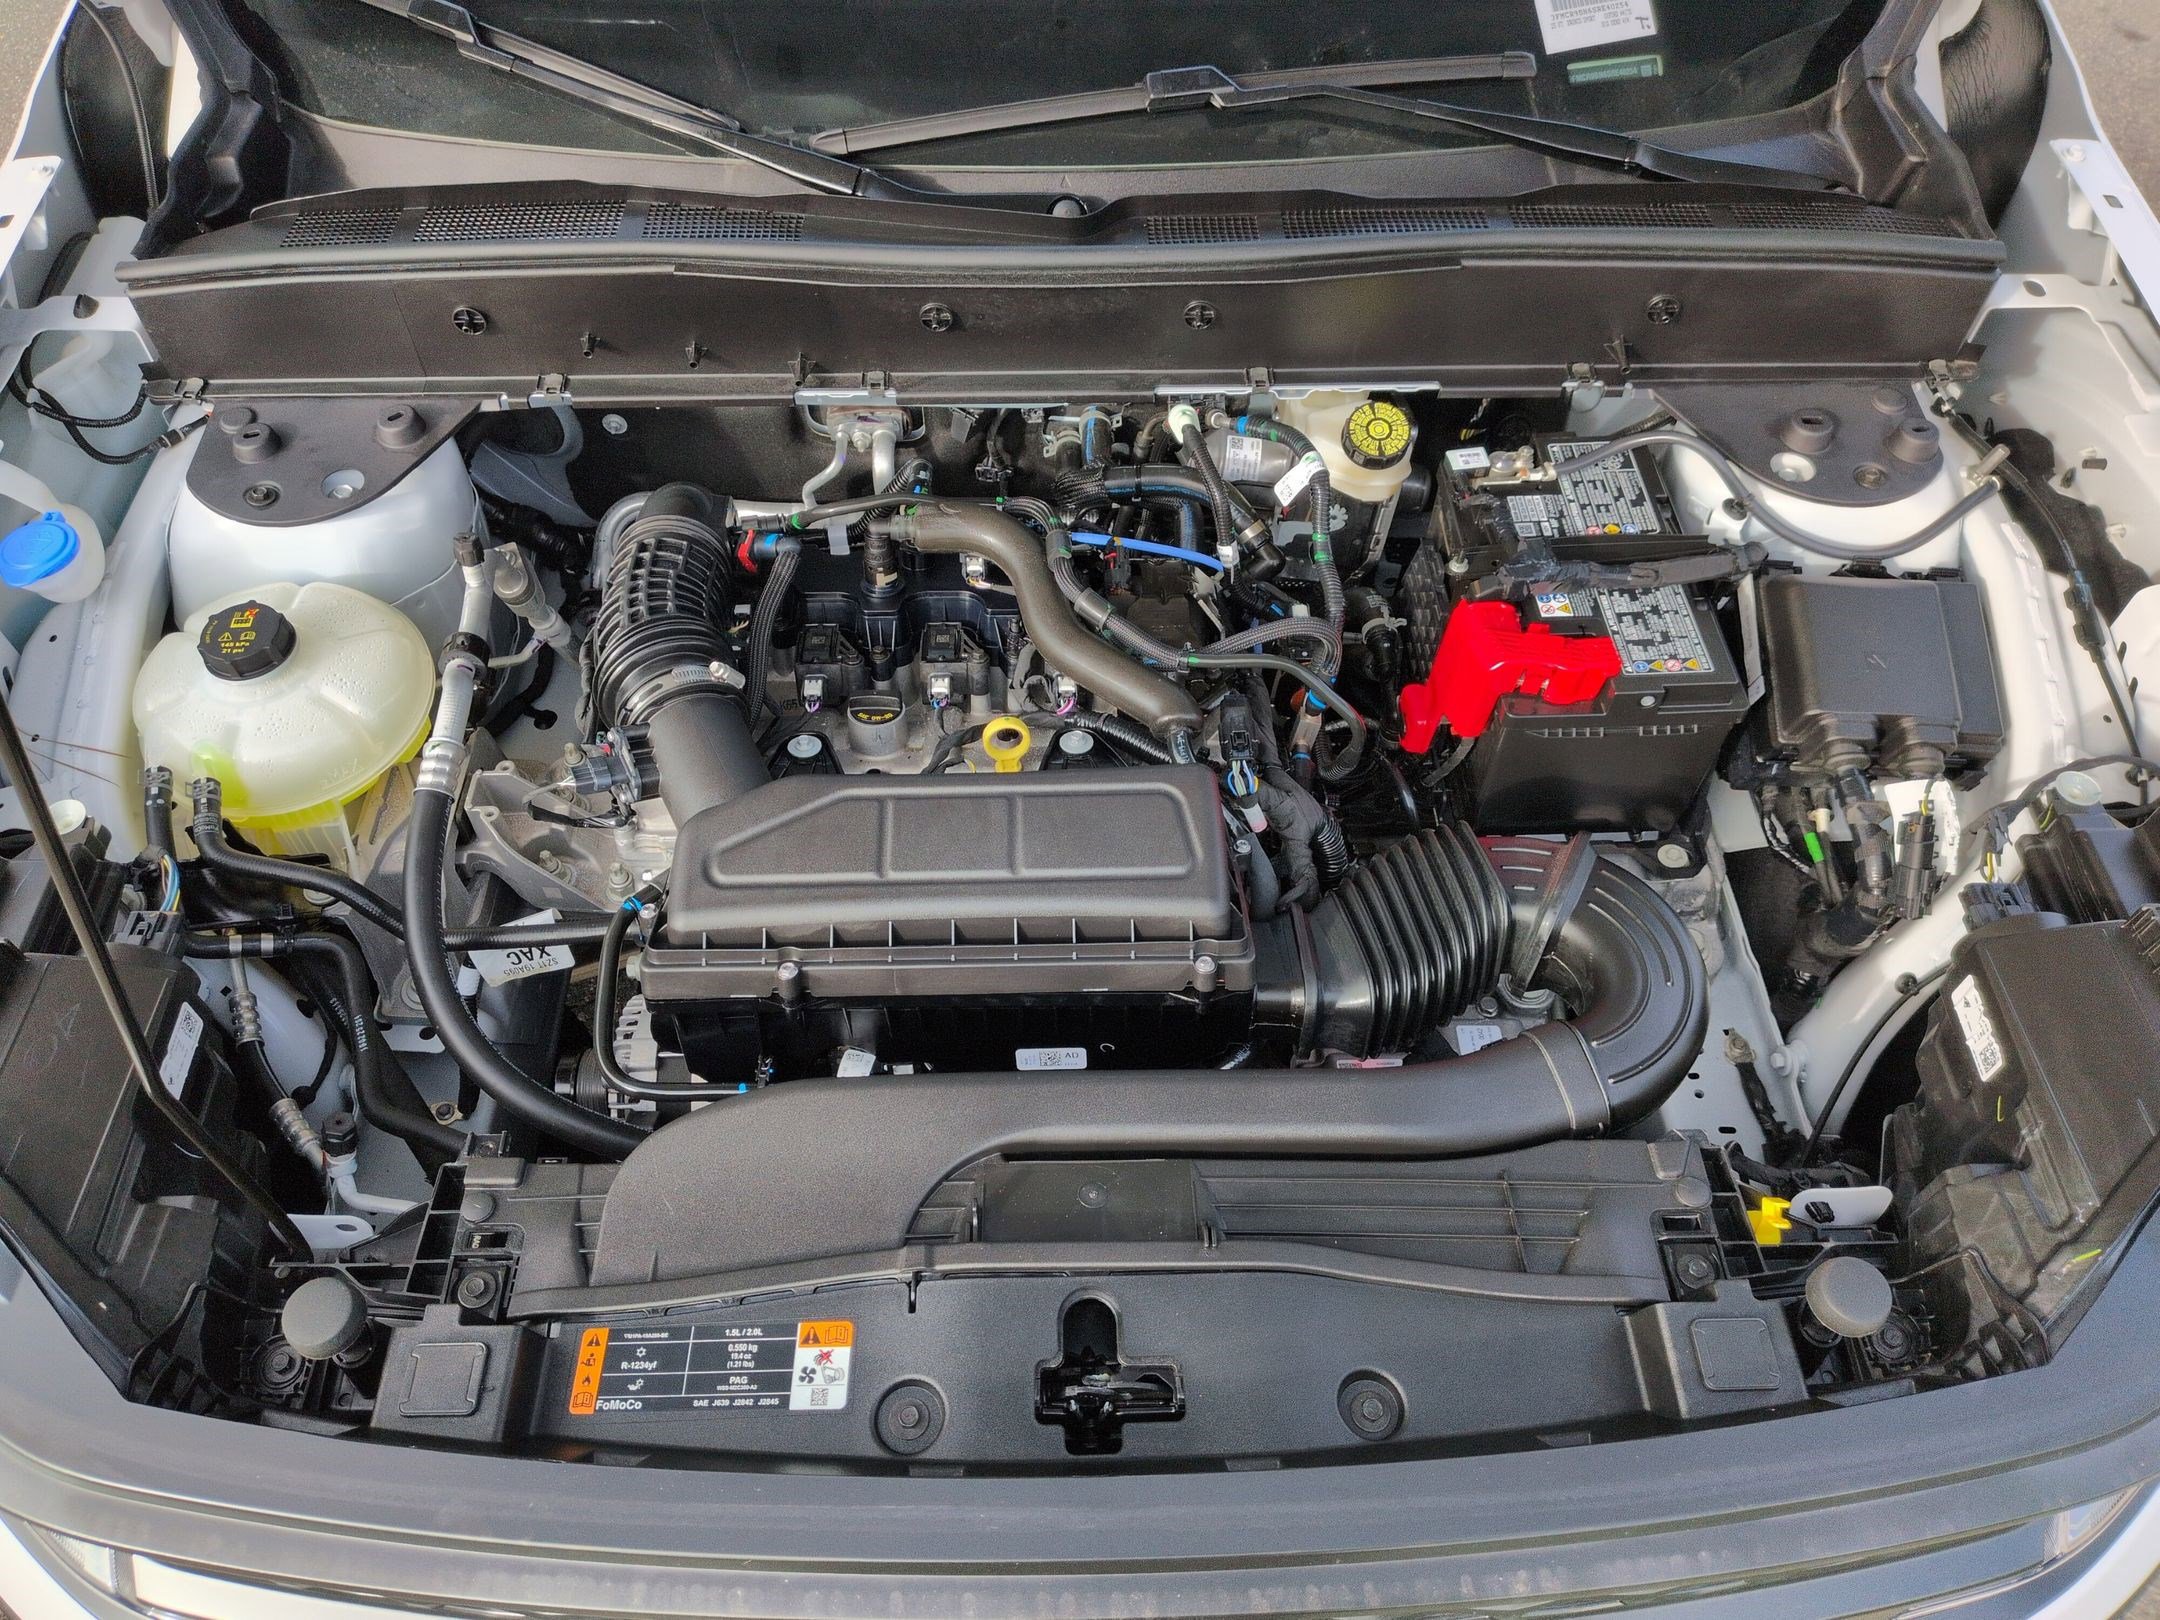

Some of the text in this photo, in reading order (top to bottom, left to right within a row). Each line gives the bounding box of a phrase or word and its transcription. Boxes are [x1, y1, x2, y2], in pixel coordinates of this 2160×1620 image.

[506, 946, 552, 965] XAC
[725, 1328, 741, 1337] 1.5L
[746, 1327, 763, 1336] 2.0L
[728, 1343, 758, 1353] 0.550 kg
[620, 1361, 658, 1370] R-1234yf
[729, 1376, 748, 1384] PAG
[595, 1399, 643, 1411] FoMoCo
[693, 1399, 709, 1407] SAE
